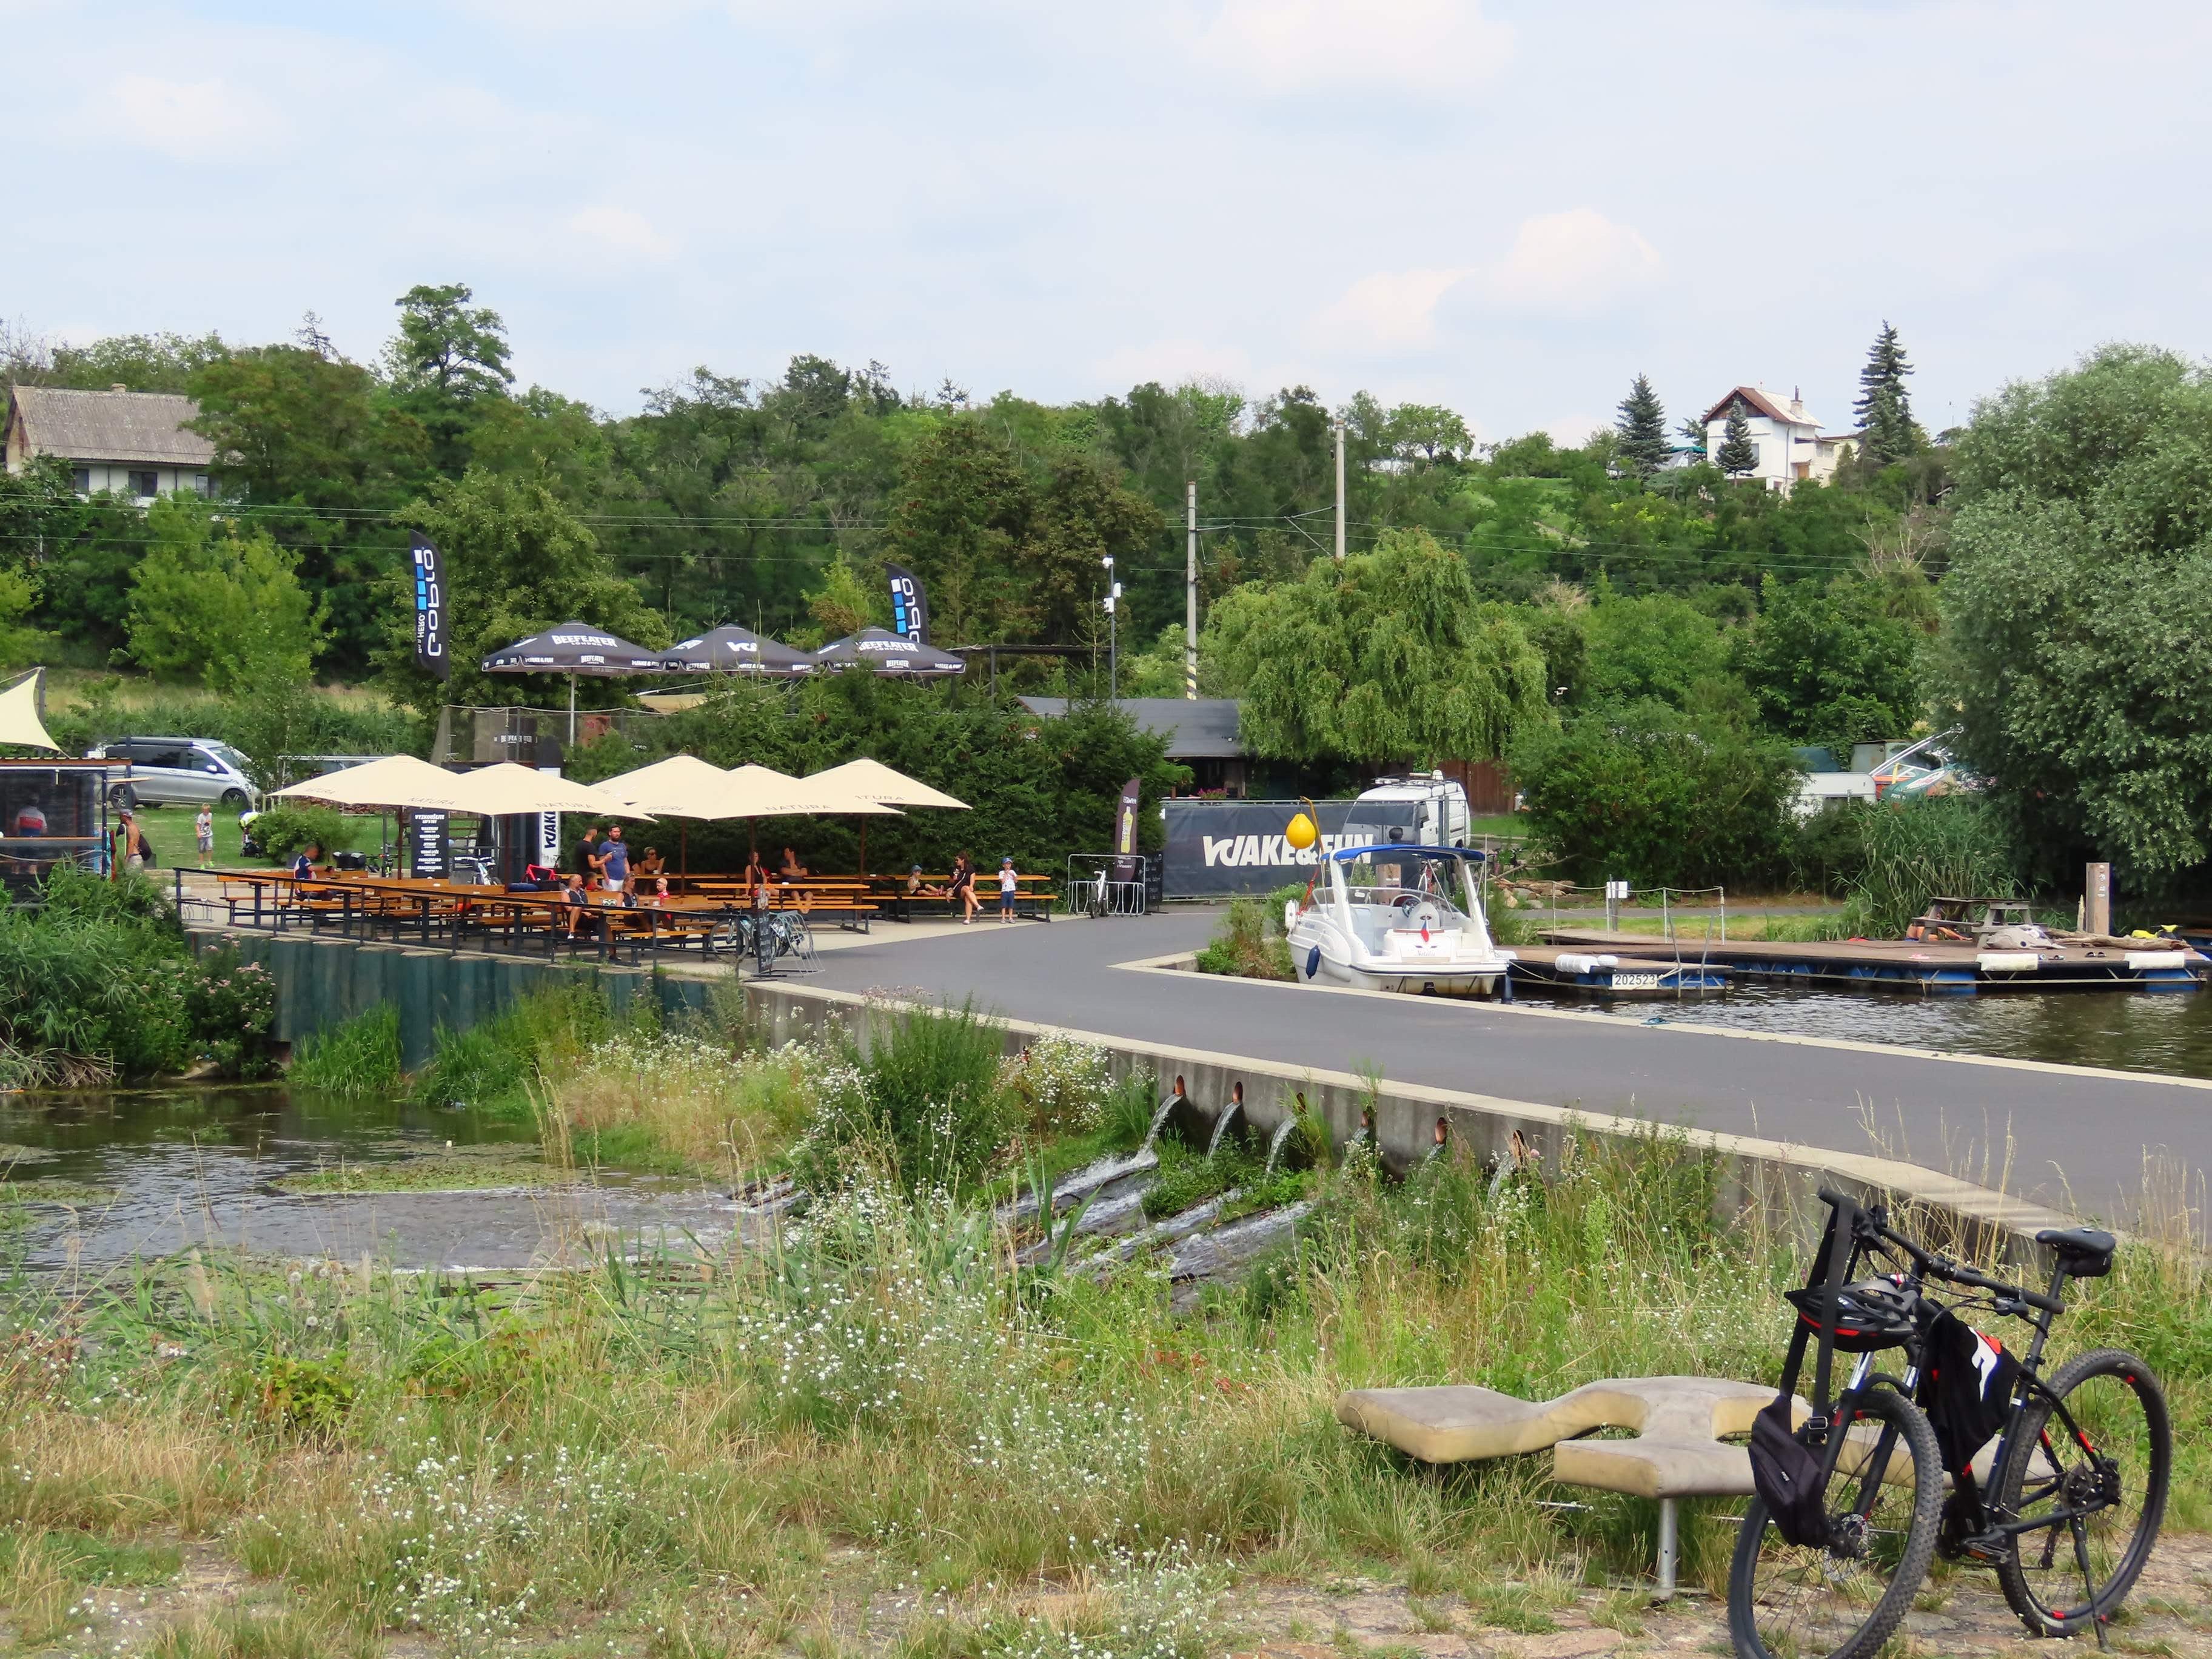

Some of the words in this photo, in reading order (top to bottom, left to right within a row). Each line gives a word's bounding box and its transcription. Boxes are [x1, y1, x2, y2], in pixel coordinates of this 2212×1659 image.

[551, 635, 618, 647] BEEFEATER
[581, 655, 605, 664] BEEFEATER
[886, 660, 910, 668] BEEFEATER
[1615, 974, 1655, 985] 202523
